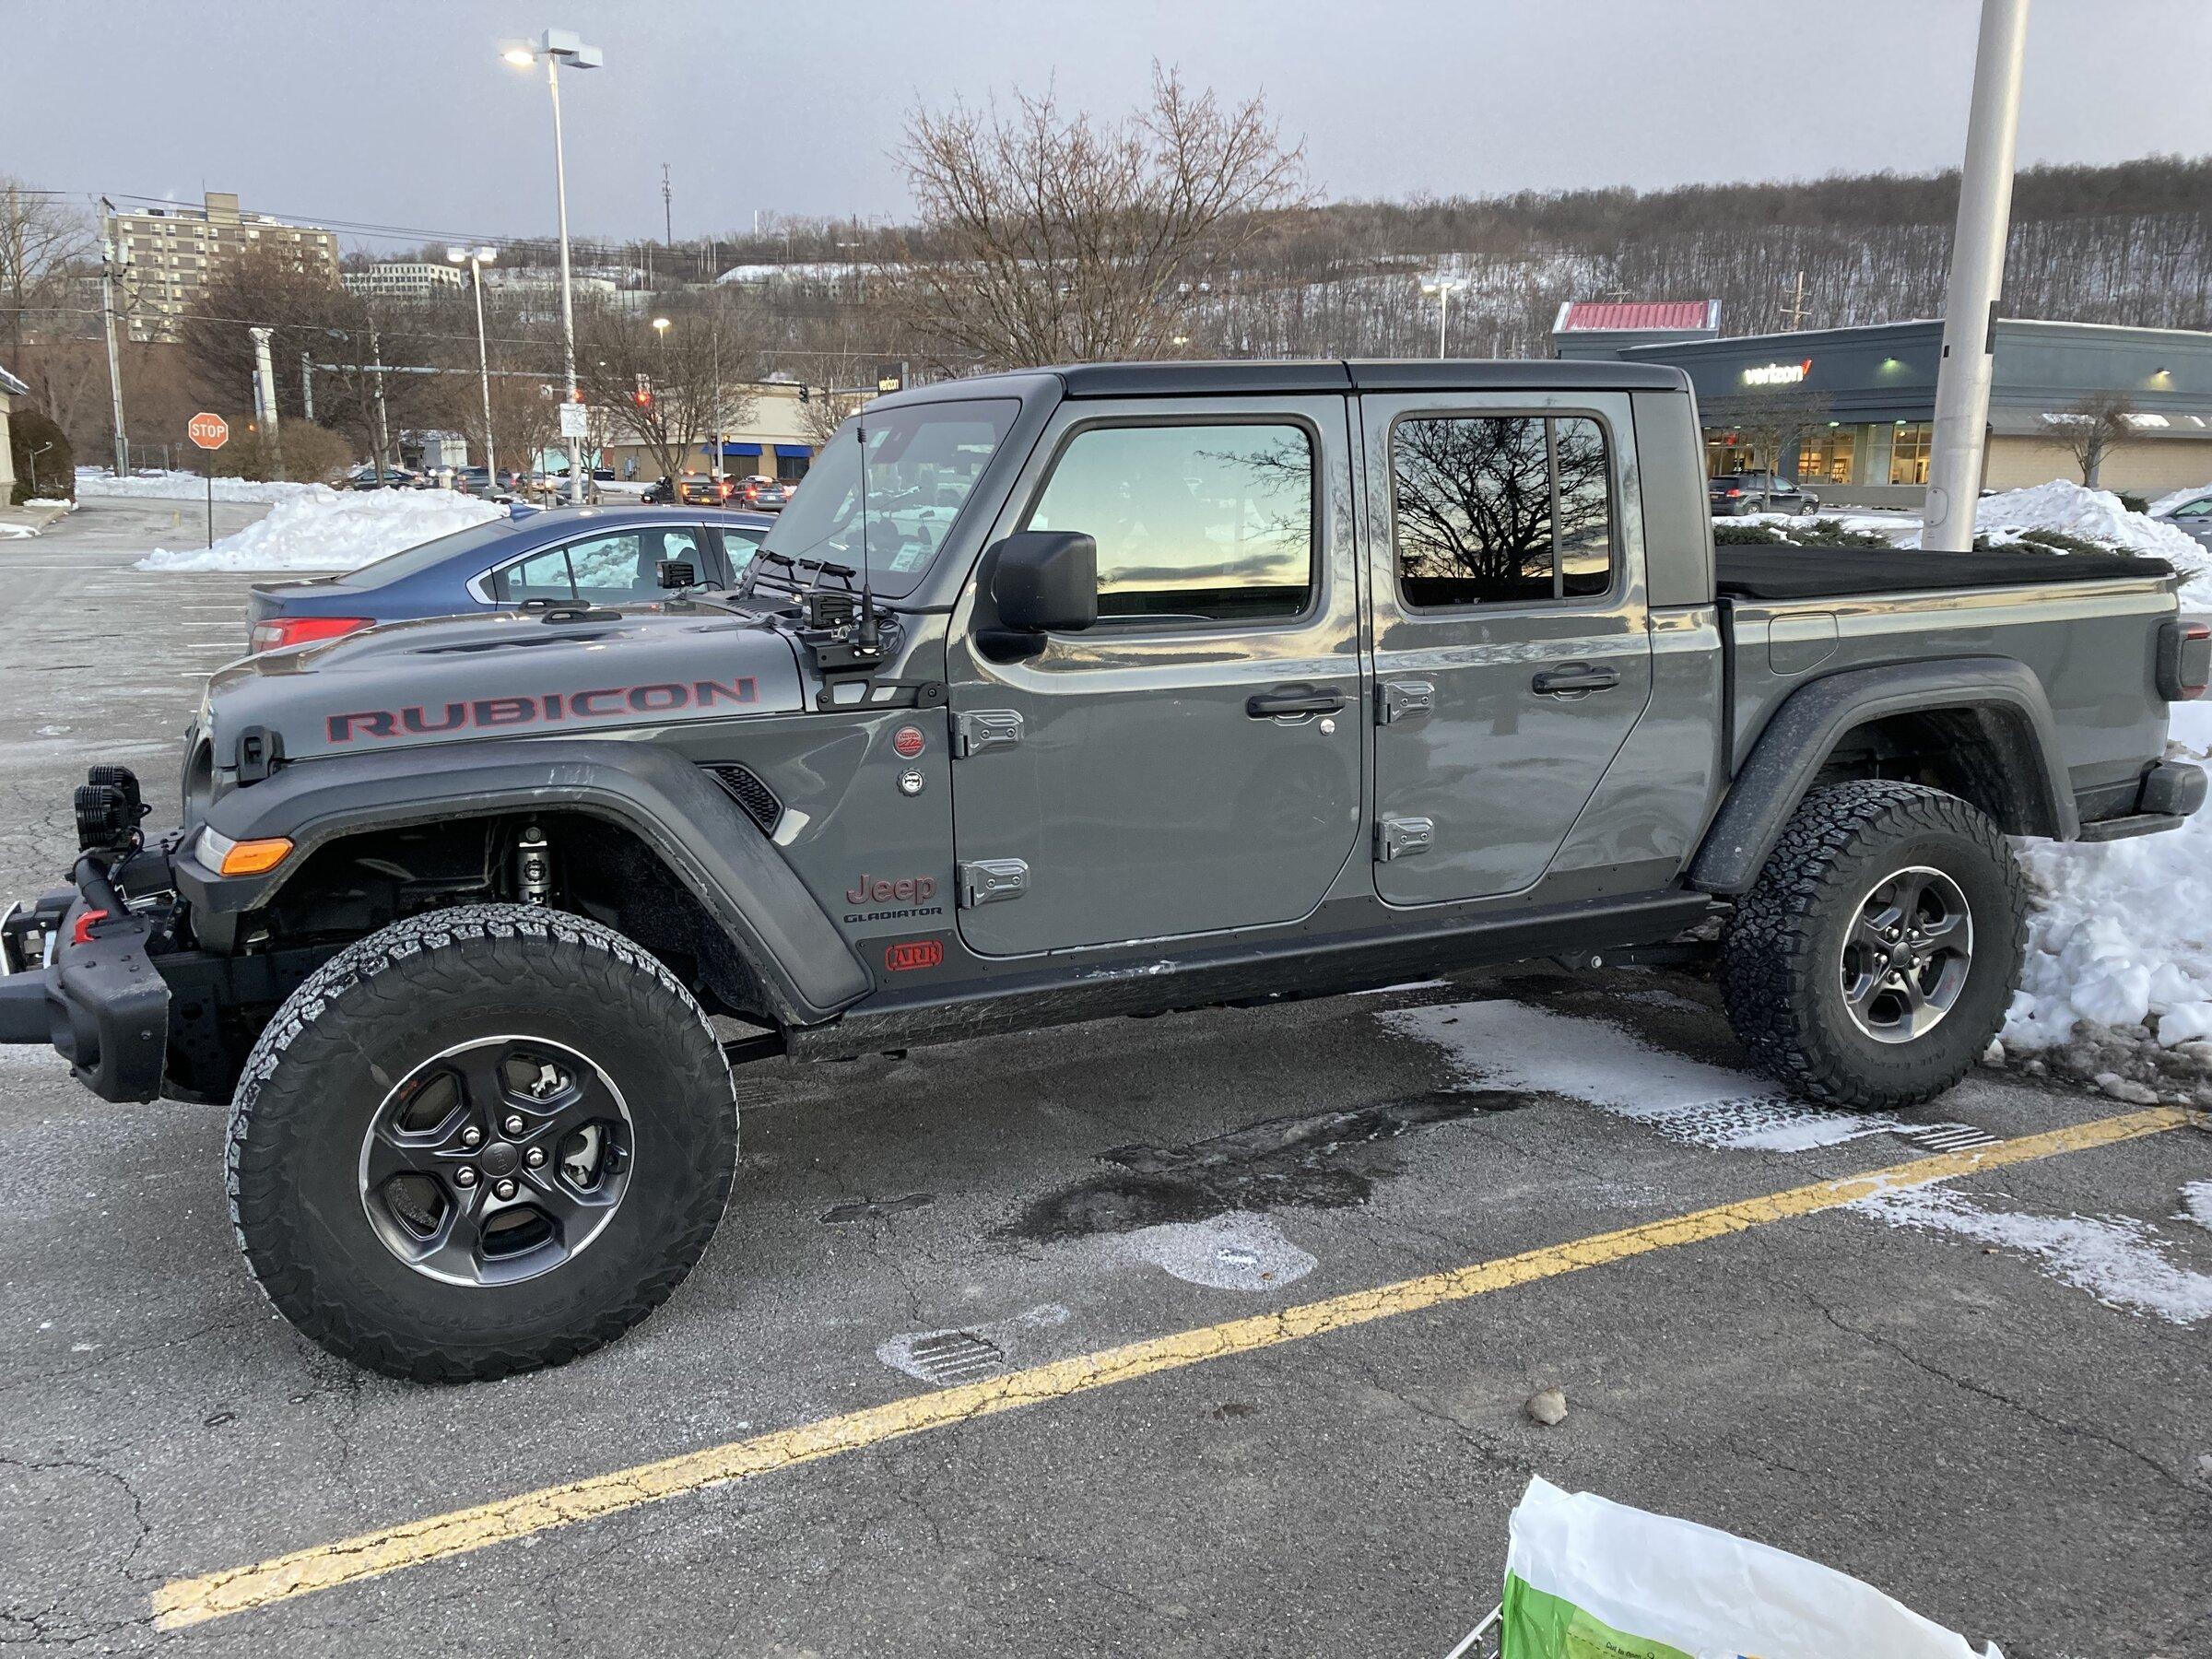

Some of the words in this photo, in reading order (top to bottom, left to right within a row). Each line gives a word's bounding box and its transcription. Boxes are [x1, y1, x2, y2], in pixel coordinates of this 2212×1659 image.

[1744, 363, 1804, 384] verizon
[878, 376, 900, 391] verizon
[192, 423, 226, 438] STOP
[325, 677, 759, 745] RUBICON
[846, 874, 936, 905] Jeep
[843, 906, 943, 924] GLADIATOR
[893, 947, 939, 967] ARB
[1606, 1641, 1617, 1653] Cut
